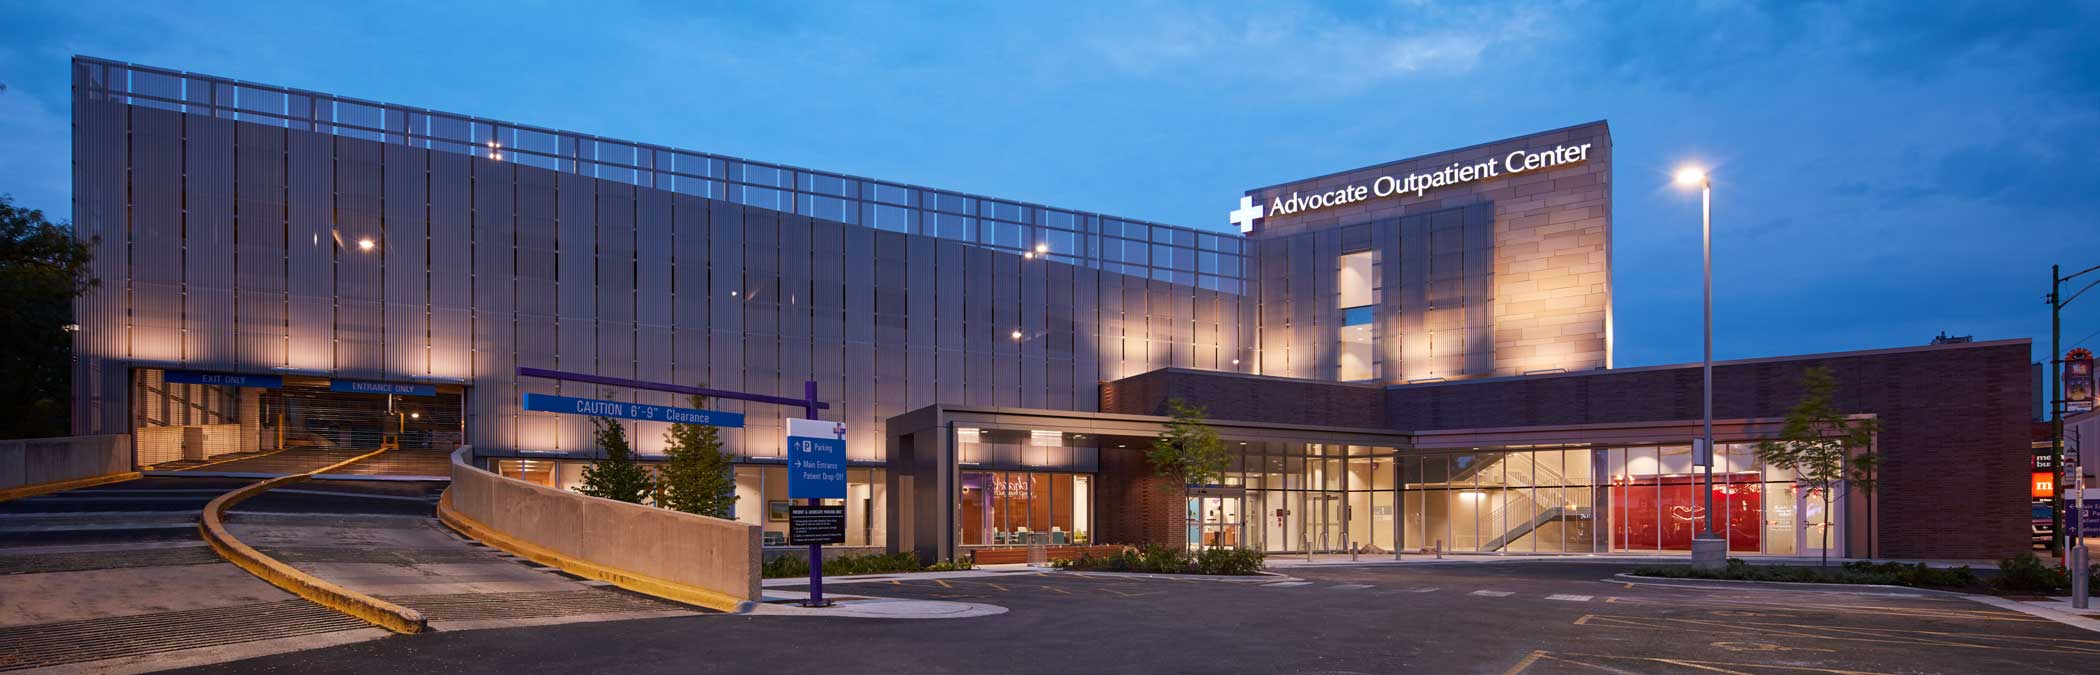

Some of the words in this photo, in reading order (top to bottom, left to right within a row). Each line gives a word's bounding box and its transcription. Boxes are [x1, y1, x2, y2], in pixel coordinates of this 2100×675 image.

[1269, 184, 1368, 216] Advocate
[1373, 157, 1498, 196] Outpatient
[1505, 142, 1591, 173] Center
[202, 374, 220, 384] EXIT
[224, 376, 246, 385] ONLY
[352, 382, 392, 392] ENTRANCE
[395, 384, 415, 393] ONLY
[576, 400, 622, 416] CAUTION
[631, 405, 658, 418] 6'-9"
[666, 408, 710, 424] Clearance
[815, 443, 832, 453] Parking
[803, 460, 816, 469] Main
[817, 461, 838, 470] Entrance
[803, 472, 821, 480] Patient
[822, 472, 844, 481] Drop-Off
